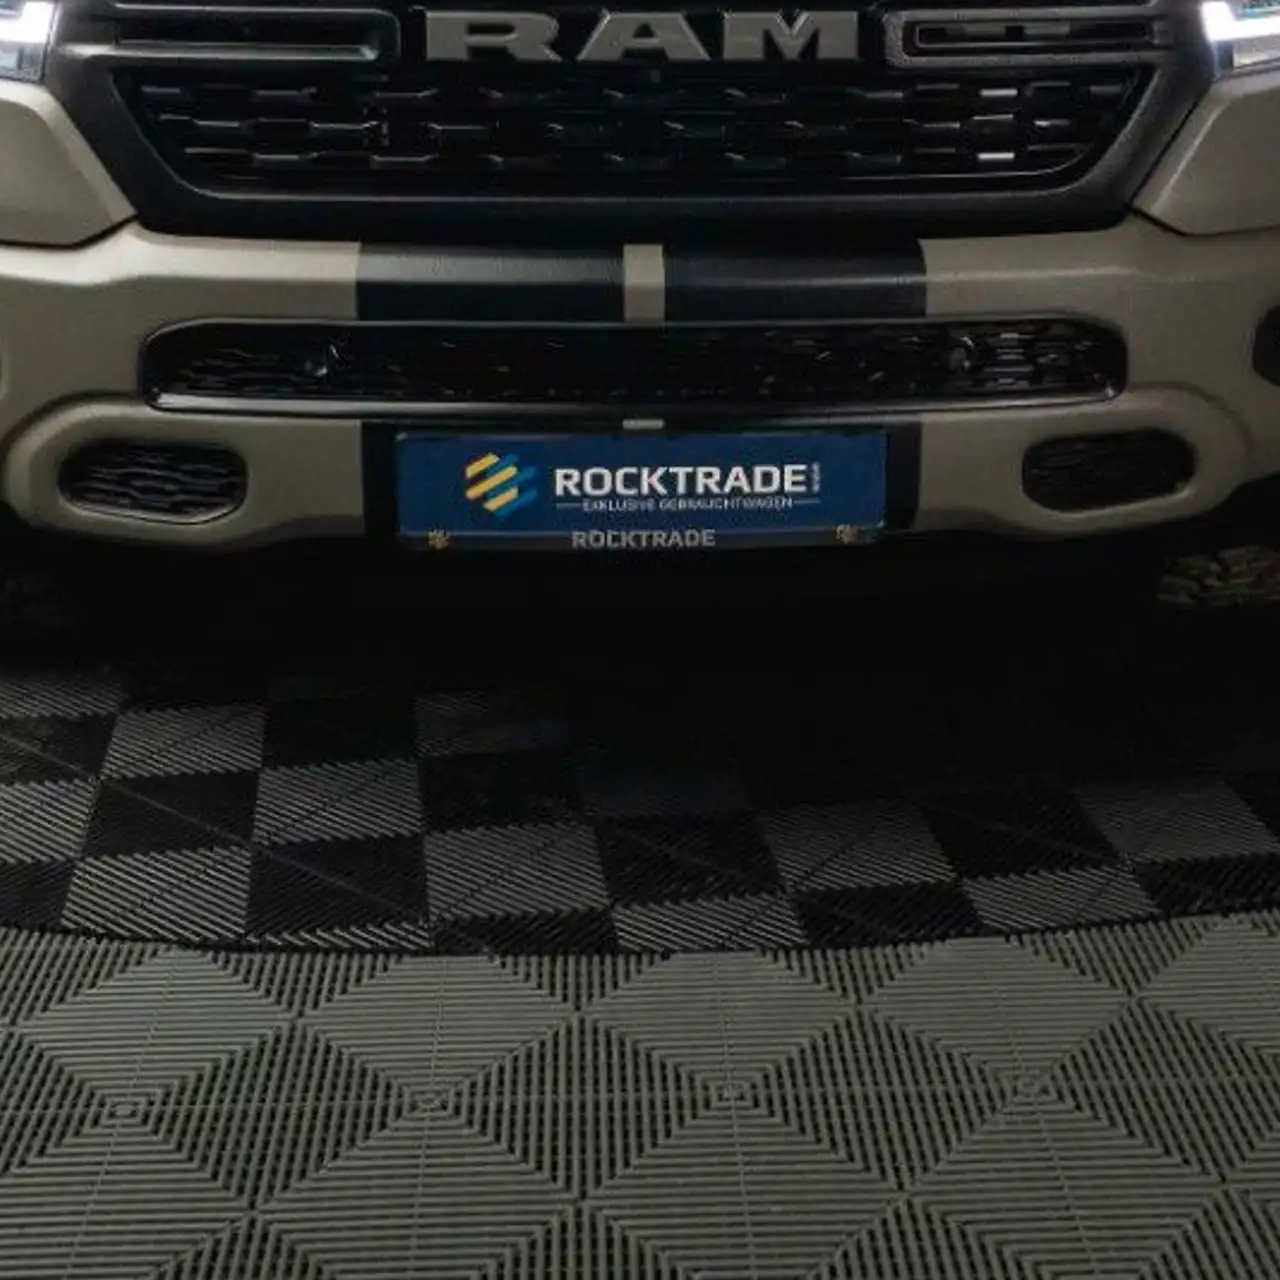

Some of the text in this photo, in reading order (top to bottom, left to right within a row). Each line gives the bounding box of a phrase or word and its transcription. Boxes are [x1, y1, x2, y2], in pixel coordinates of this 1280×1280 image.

[426, 11, 859, 61] RAM
[555, 464, 808, 496] ROCKTRADE
[572, 528, 716, 549] ROCKTRADE
